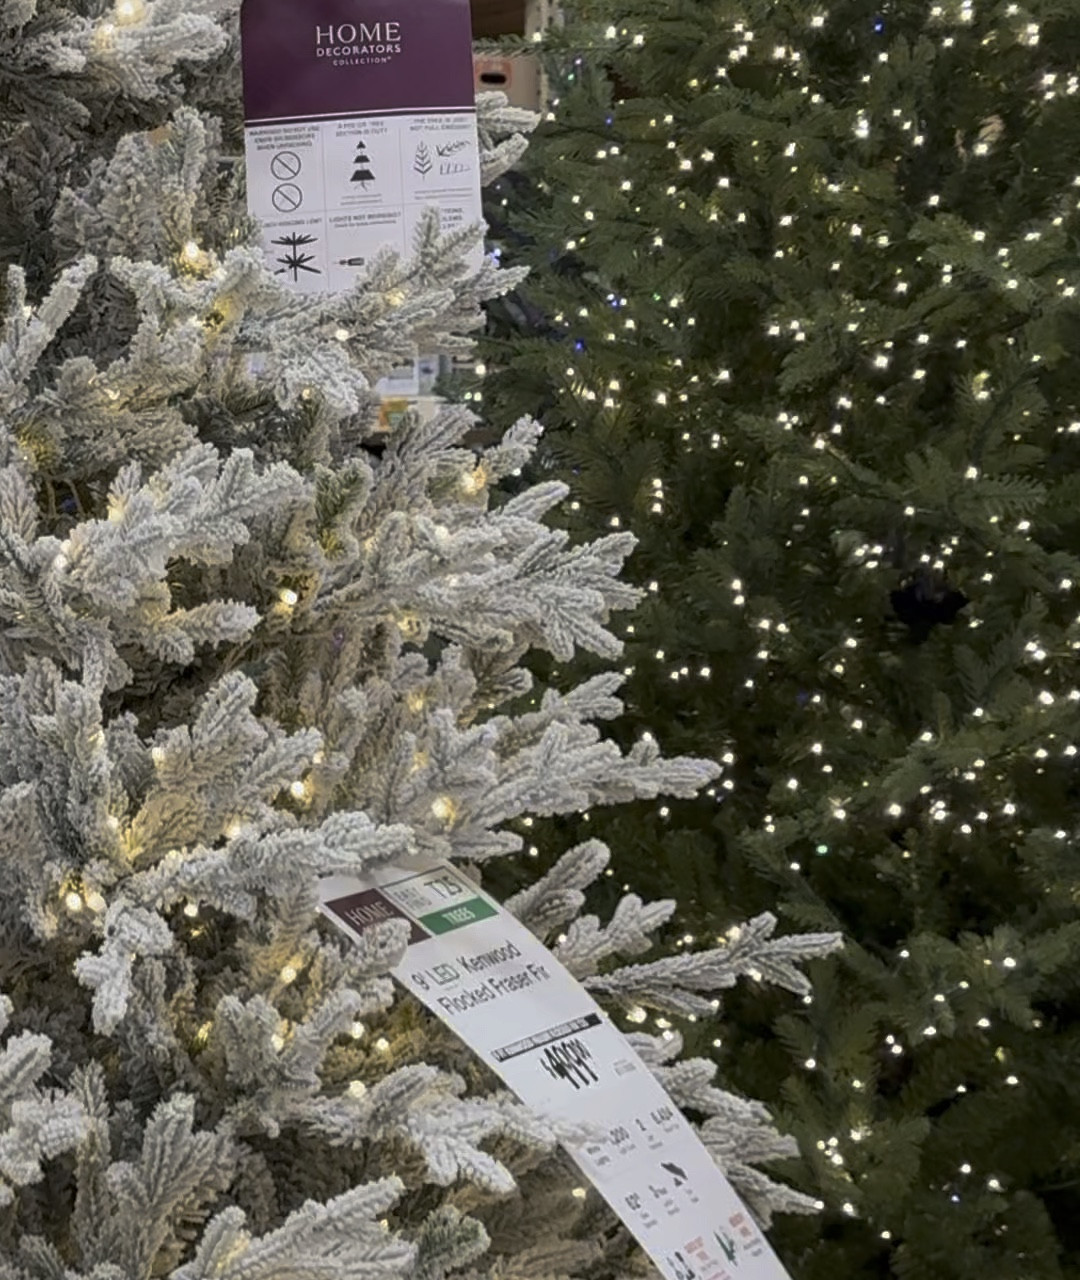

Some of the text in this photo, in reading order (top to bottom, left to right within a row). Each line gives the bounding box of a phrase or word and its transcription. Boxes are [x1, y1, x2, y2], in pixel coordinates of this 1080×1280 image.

[315, 22, 401, 45] HOME
[316, 43, 402, 57] DECORATORS
[424, 876, 463, 900] T25
[344, 901, 395, 927] HOME
[441, 907, 476, 925] TREES
[425, 962, 461, 987] LED
[457, 939, 522, 974] Kenwood
[437, 963, 551, 1016] Flocked Fraser Fir
